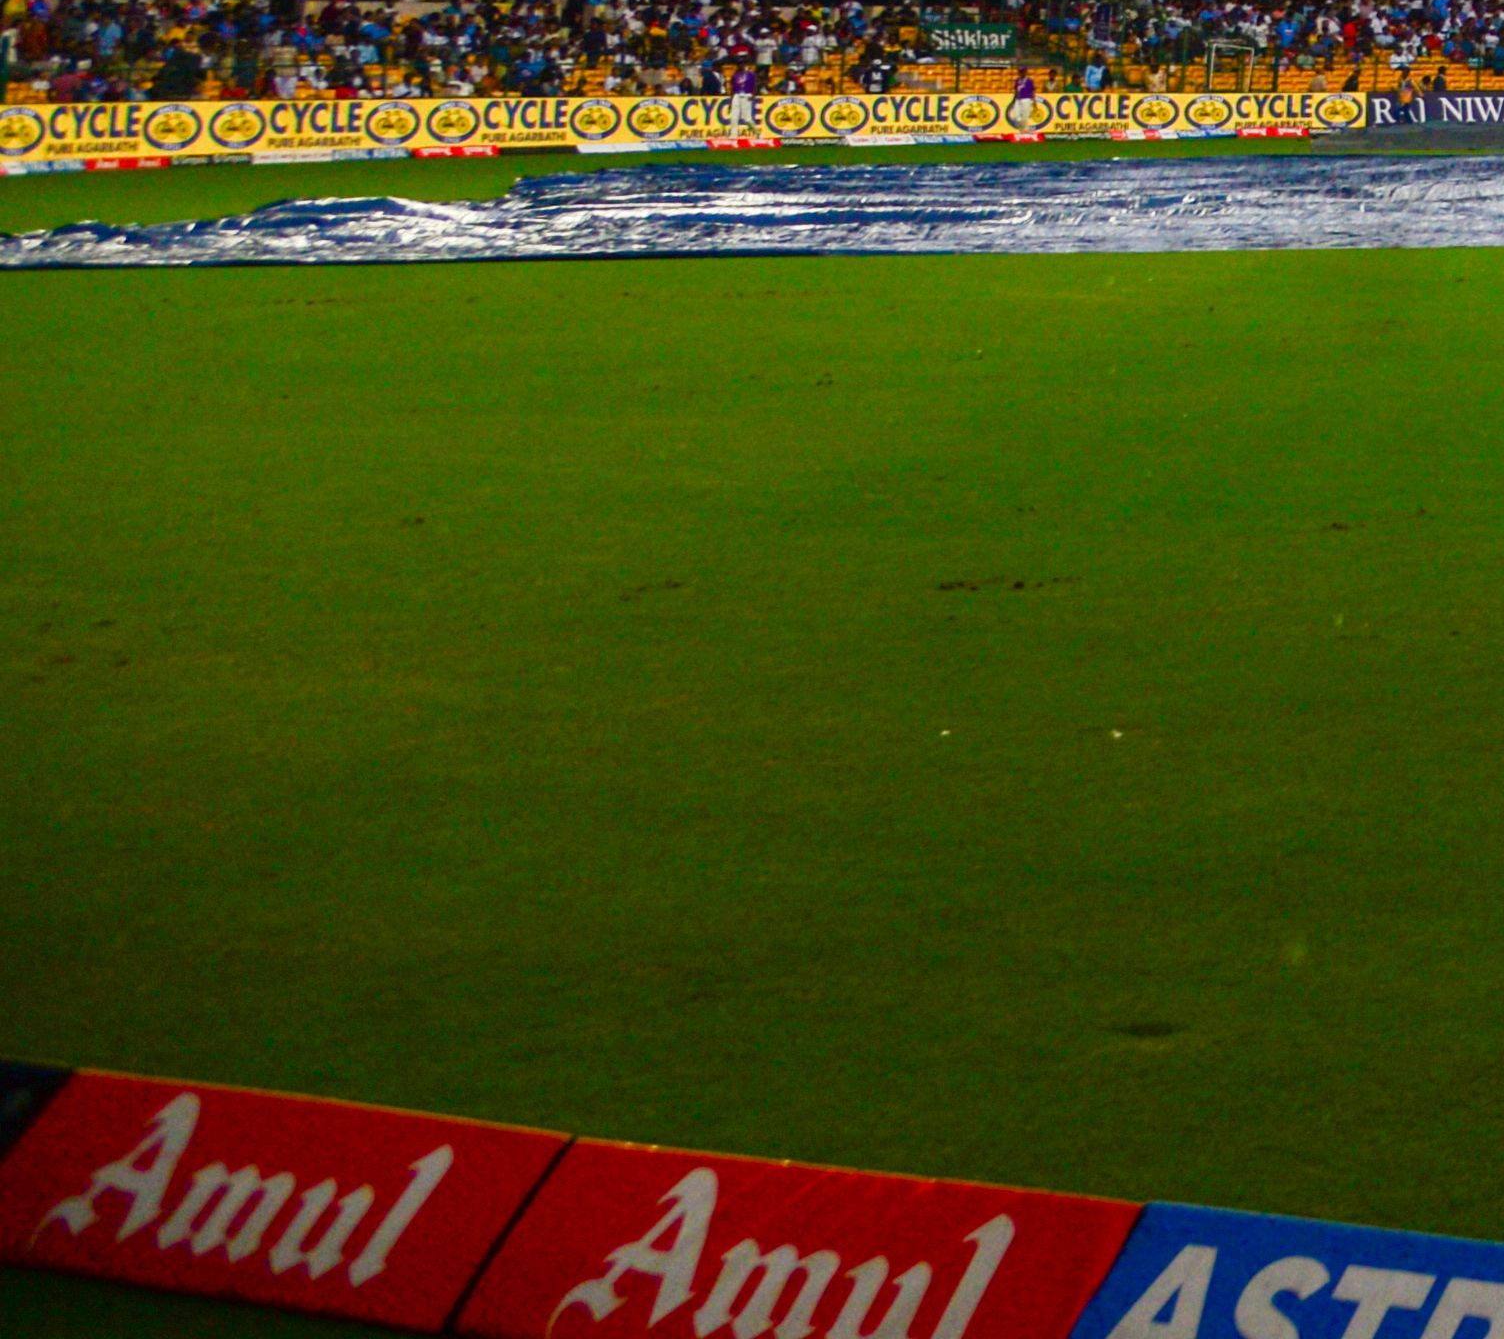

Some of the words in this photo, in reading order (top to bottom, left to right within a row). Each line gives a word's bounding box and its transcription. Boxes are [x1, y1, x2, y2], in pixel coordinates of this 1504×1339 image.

[50, 105, 143, 140] CYCLE
[872, 96, 950, 123] CYCLE
[870, 125, 894, 134] PURE
[27, 1091, 453, 1288] Amul
